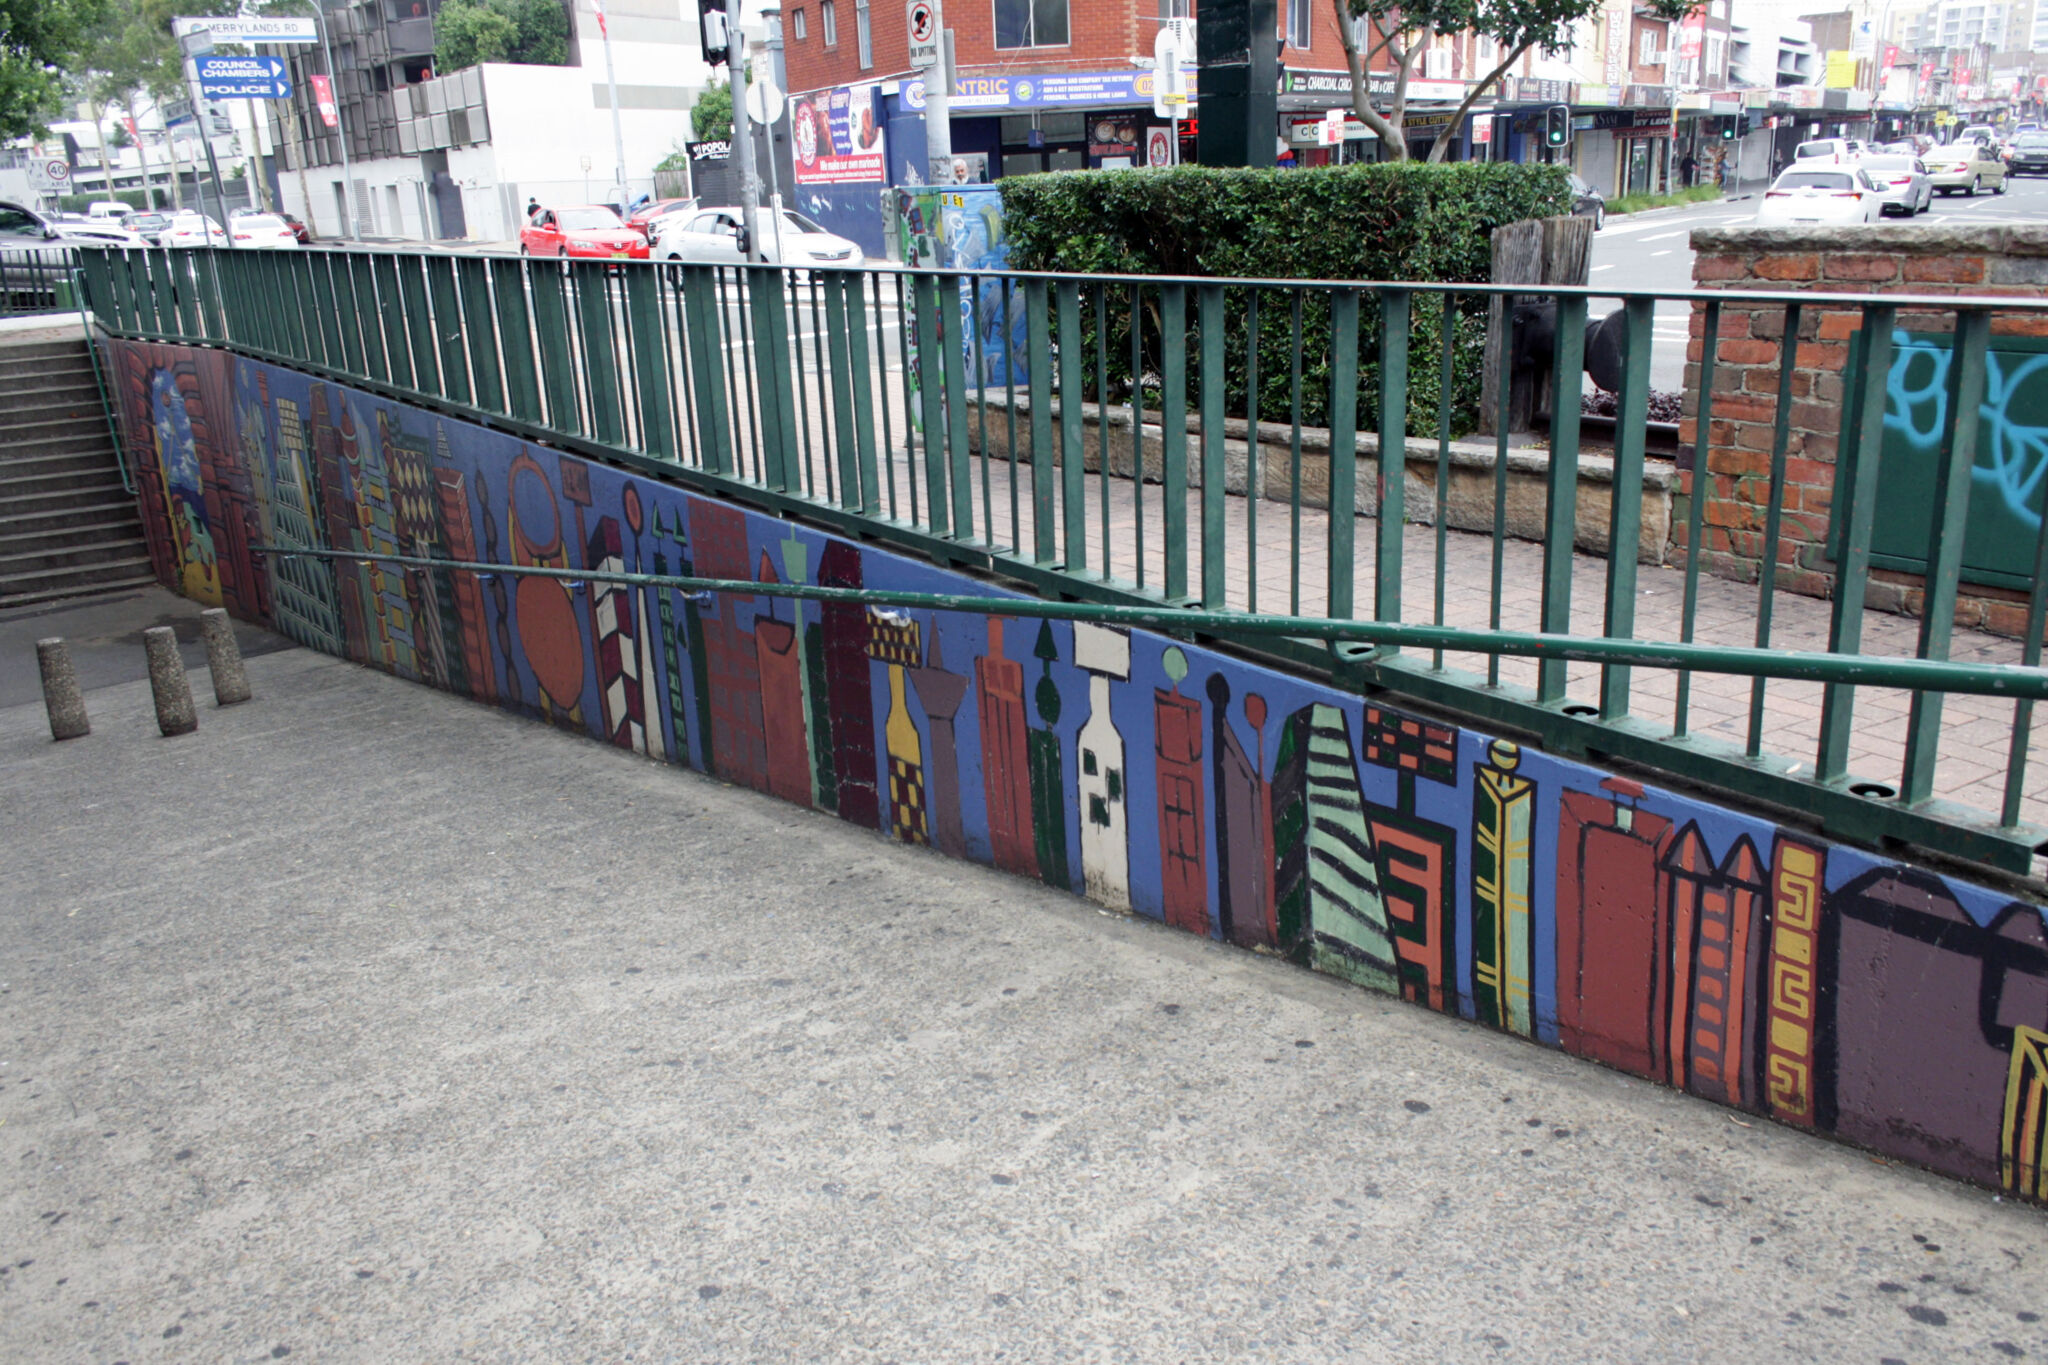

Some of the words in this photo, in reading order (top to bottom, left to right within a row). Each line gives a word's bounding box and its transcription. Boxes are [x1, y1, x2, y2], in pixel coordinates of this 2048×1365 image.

[208, 23, 280, 33] MERRYLANDS
[284, 23, 298, 33] RD
[207, 60, 262, 69] COUNCIL
[202, 69, 270, 77] CHAMBERS
[204, 85, 272, 94] POLICE
[956, 79, 1009, 95] NTRIC
[1308, 76, 1337, 91] CHARCOAL
[1383, 81, 1396, 93] CAFE
[50, 165, 65, 175] 40
